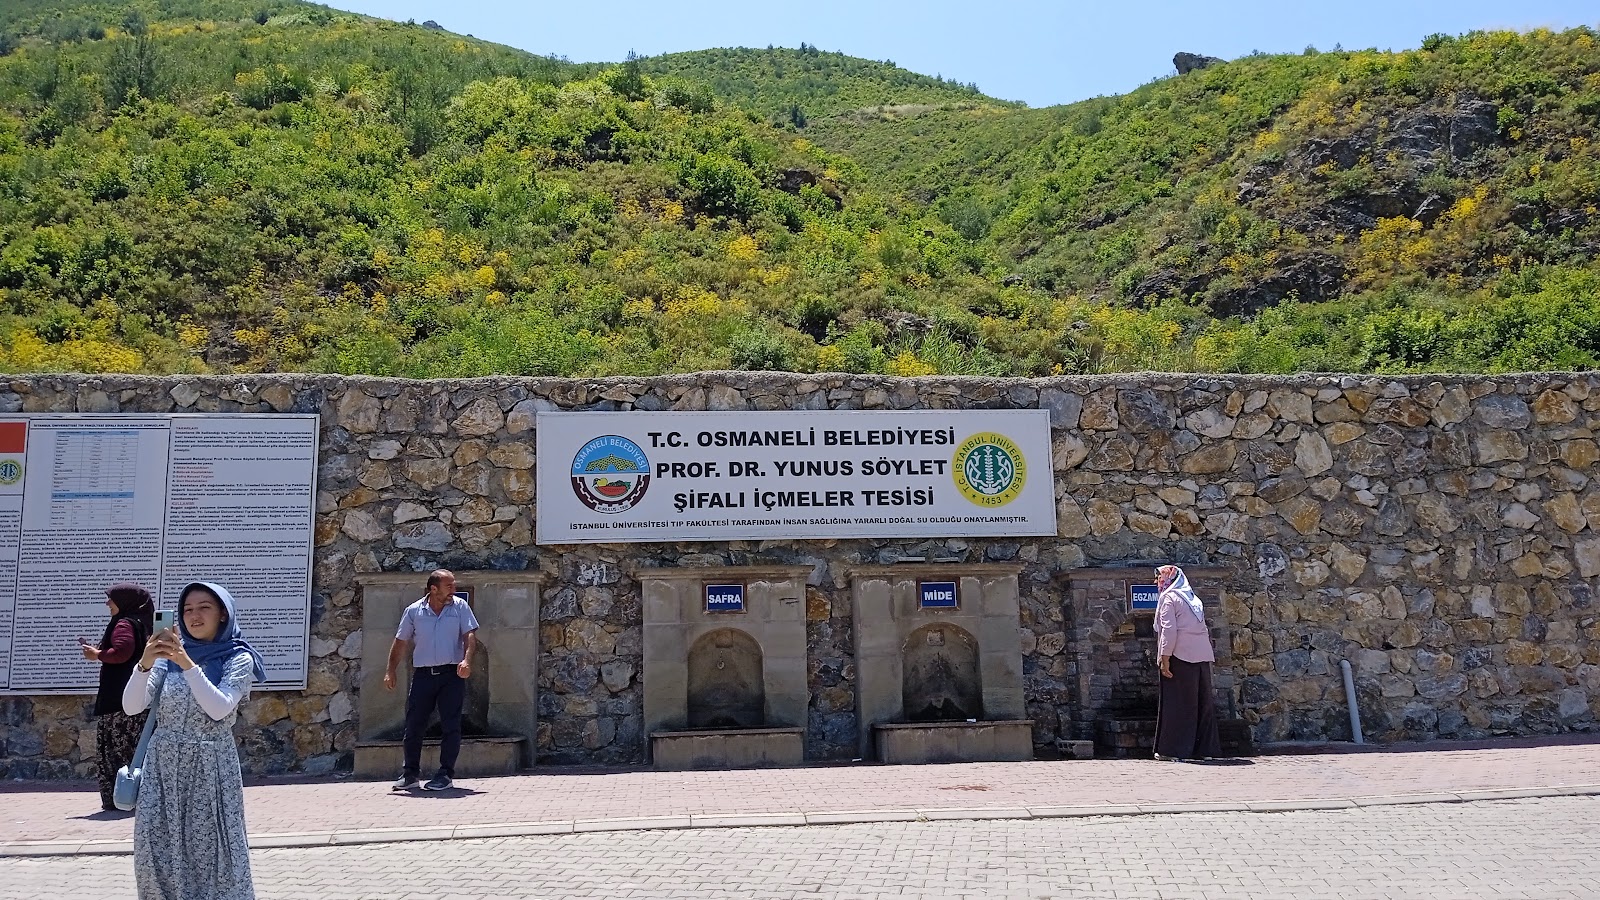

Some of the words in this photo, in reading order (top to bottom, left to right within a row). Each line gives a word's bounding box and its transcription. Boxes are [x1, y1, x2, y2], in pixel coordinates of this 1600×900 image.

[647, 432, 689, 447] T.C.
[697, 427, 815, 447] OSMANELİ
[823, 426, 955, 446] BELEDİYESİ
[574, 438, 608, 470] OSMANELİ
[610, 438, 647, 469] BELEDİYESİ
[954, 436, 987, 473] İSTANBUL
[656, 462, 721, 479] PROF.
[729, 461, 766, 477] DR.
[773, 461, 854, 477] YUNUS
[861, 456, 948, 476] SÖYLET
[990, 434, 1025, 494] ÜNİVERSİTESİ
[958, 475, 970, 493] T.C.
[673, 489, 745, 513] ŞİFALI
[754, 488, 855, 511] İÇMELER
[861, 486, 934, 506] TESİSİ
[981, 496, 1002, 505] 1453
[570, 522, 610, 530] İSTANBUL
[612, 520, 669, 529] ÜNİVERSİTESİ
[686, 518, 729, 527] FAKÜLTESİ
[783, 517, 808, 525] İNSAN
[810, 517, 852, 525] SAĞLIĞINA
[889, 516, 915, 524] DOĞAL
[964, 516, 1028, 524] ONAYLANMIŞTIR.
[708, 593, 741, 604] SAFRA
[924, 589, 952, 600] MİDE
[1133, 592, 1159, 602] EGZAM
